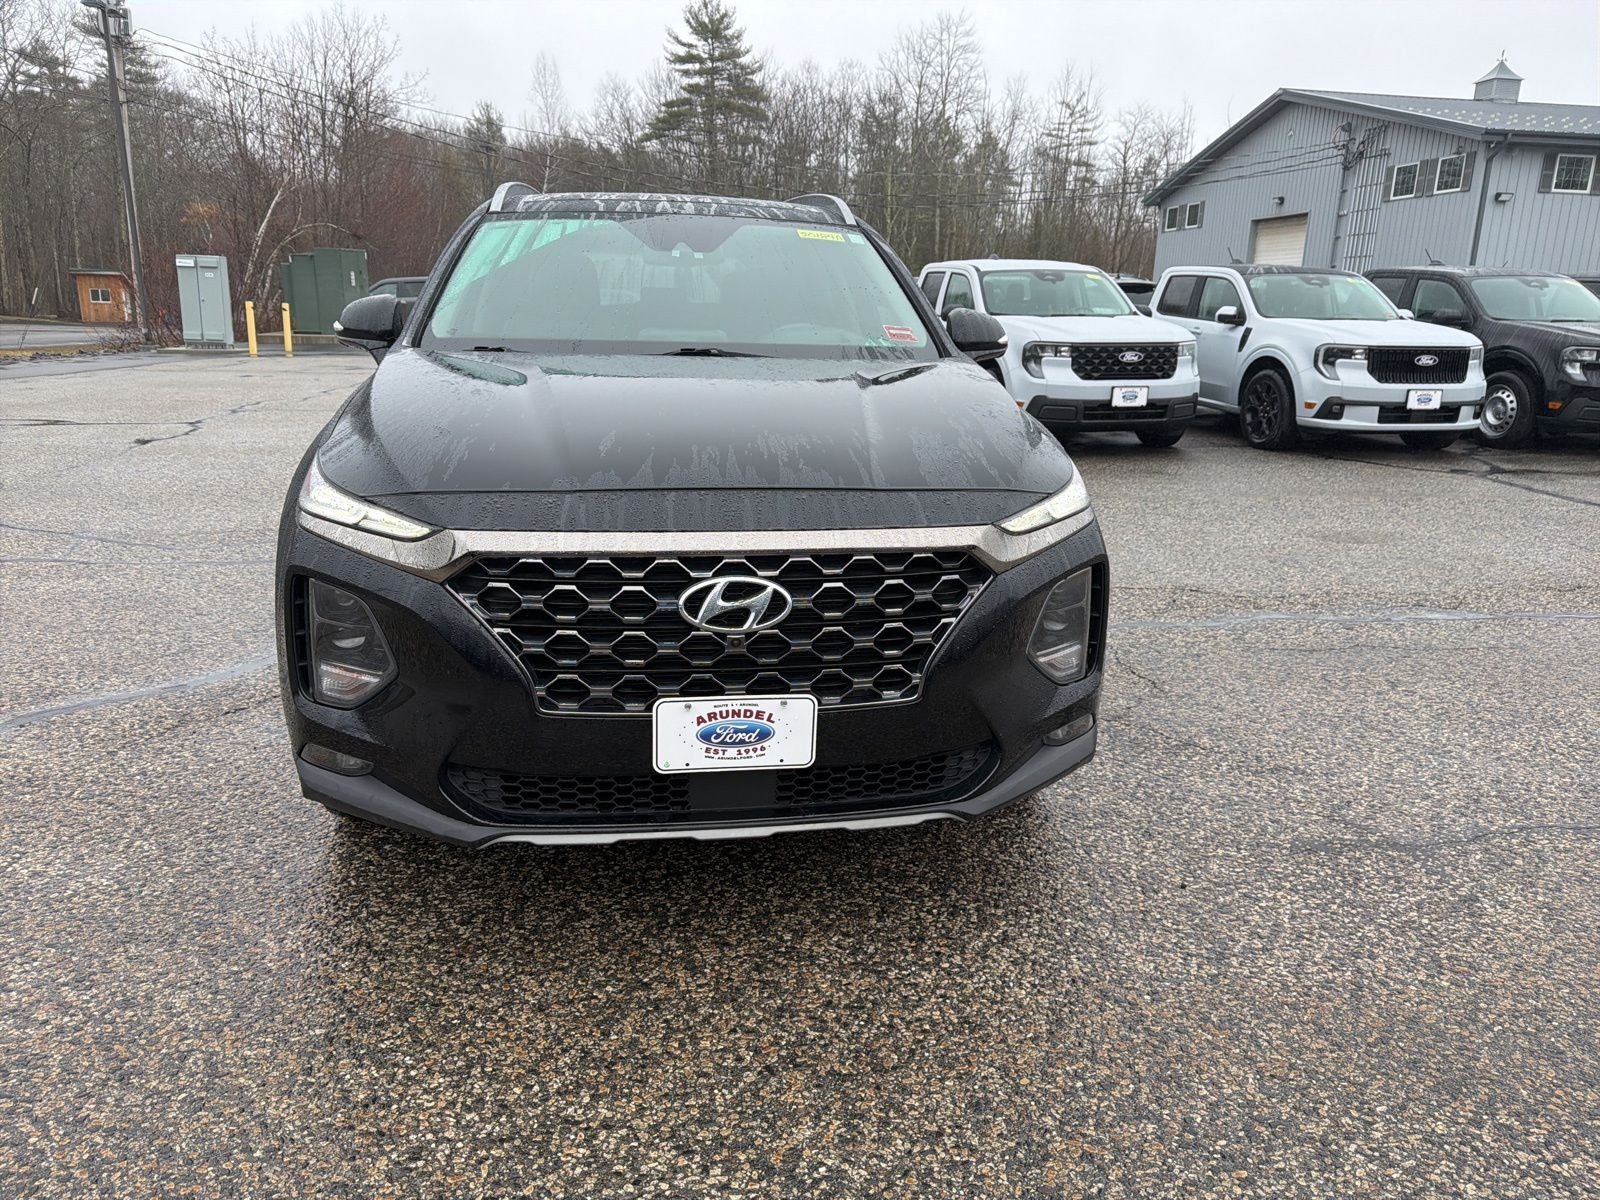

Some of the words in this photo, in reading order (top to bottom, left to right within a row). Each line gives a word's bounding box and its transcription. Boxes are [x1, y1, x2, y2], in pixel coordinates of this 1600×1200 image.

[696, 708, 775, 726] ARUNDEL
[711, 724, 760, 742] Ford
[704, 746, 728, 756] EST
[736, 745, 766, 756] 1996
